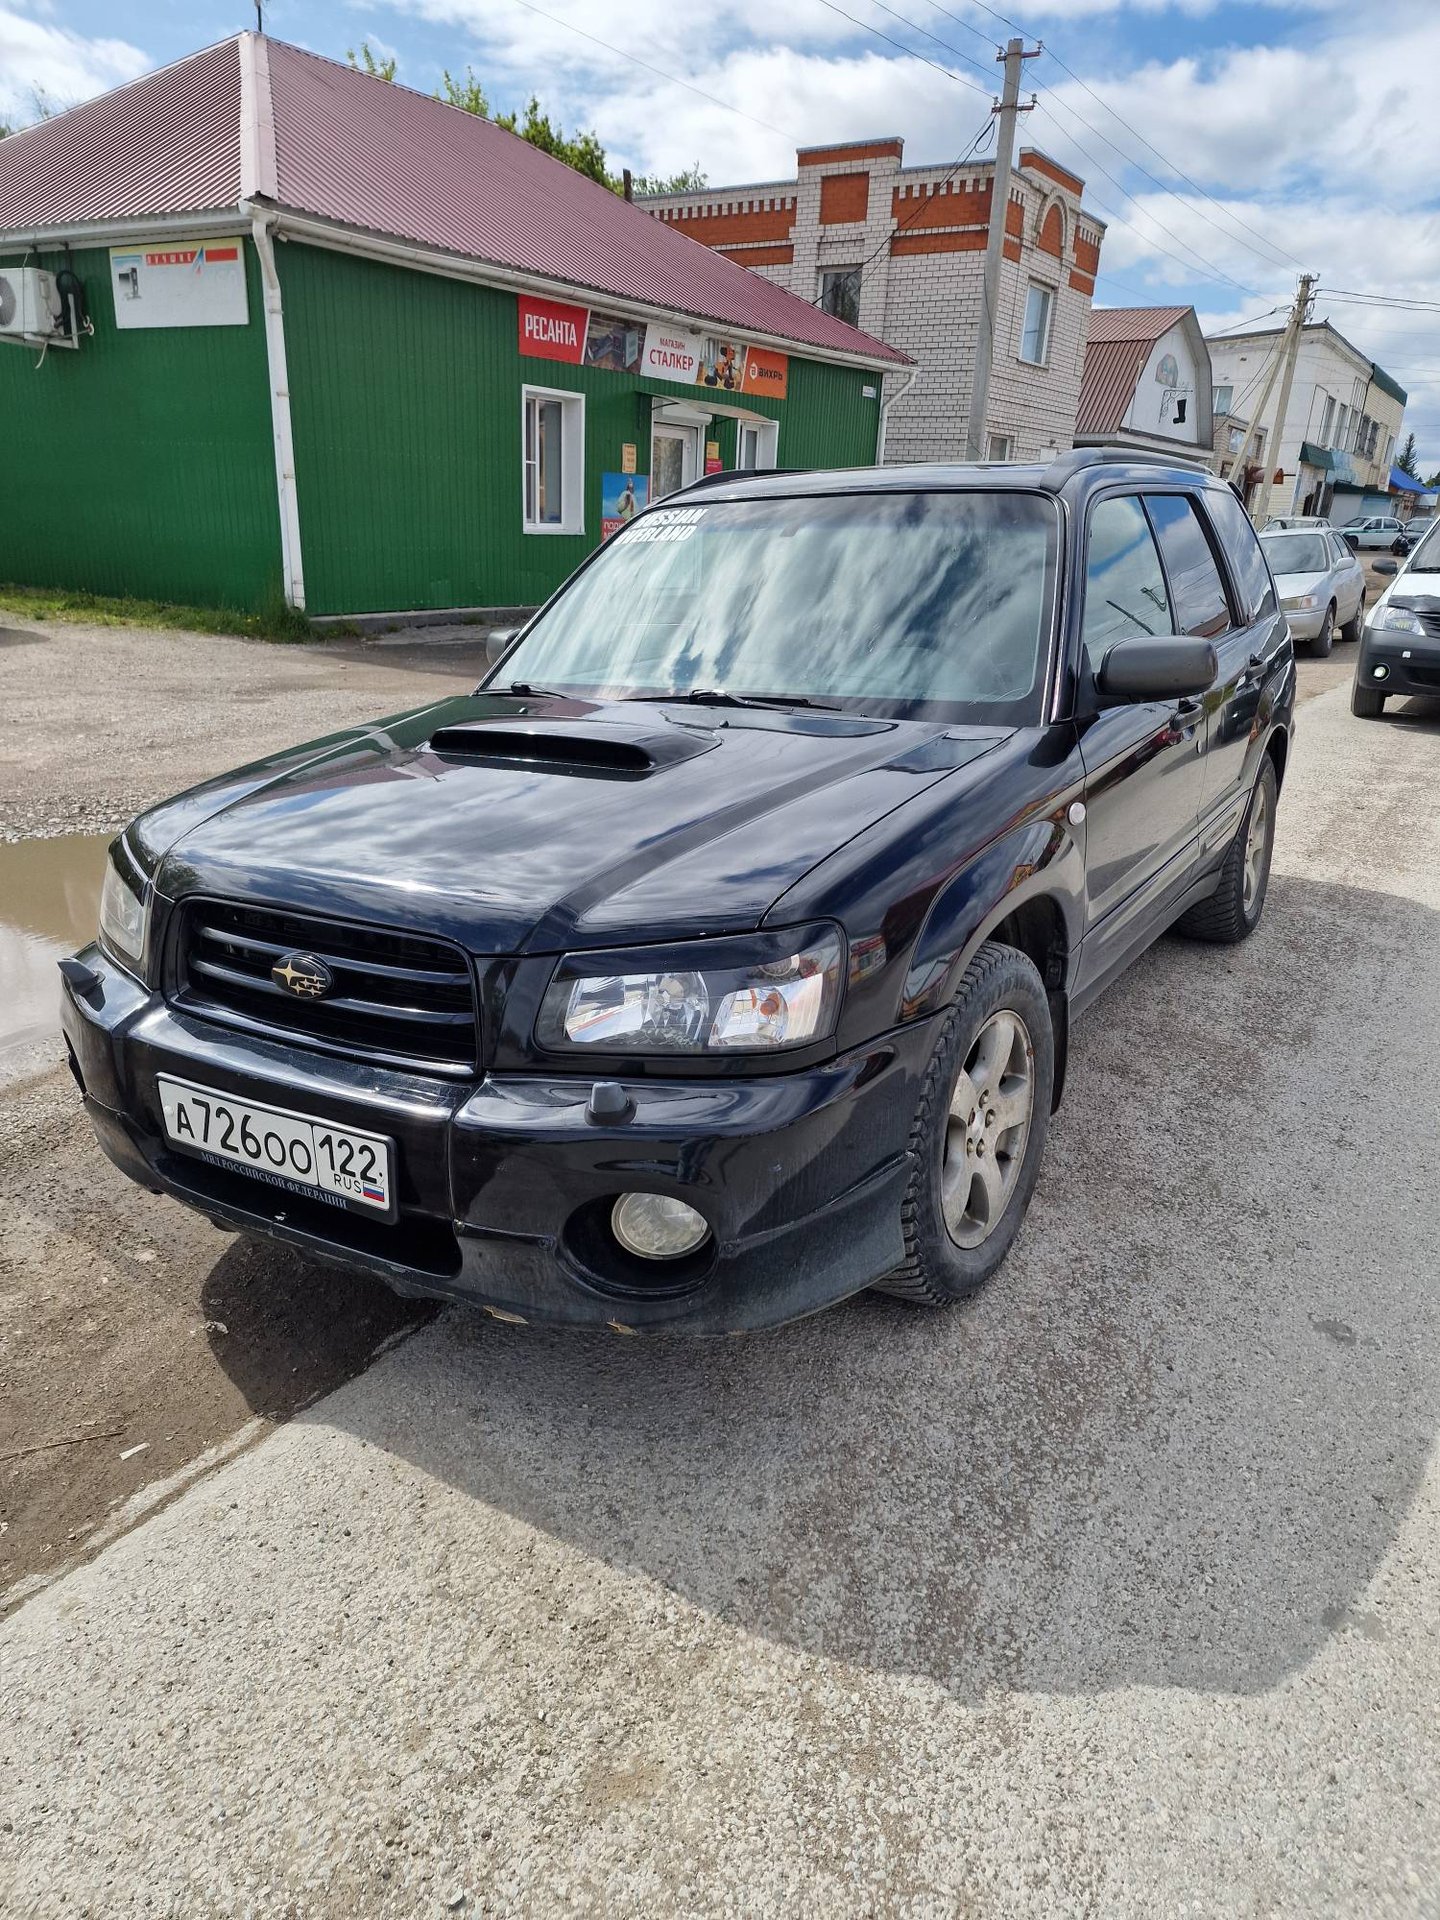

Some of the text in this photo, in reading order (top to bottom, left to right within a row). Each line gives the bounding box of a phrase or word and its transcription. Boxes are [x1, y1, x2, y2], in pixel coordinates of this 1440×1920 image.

[525, 313, 578, 347] РЕСАНТА
[659, 337, 686, 351] МАГАЗИН
[649, 348, 694, 371] СТАЛКЕР
[612, 525, 698, 546] OVERLAND
[318, 1134, 378, 1184] 122
[221, 1155, 285, 1189] РОССИЙСКОЙ
[334, 1173, 362, 1194] RUS
